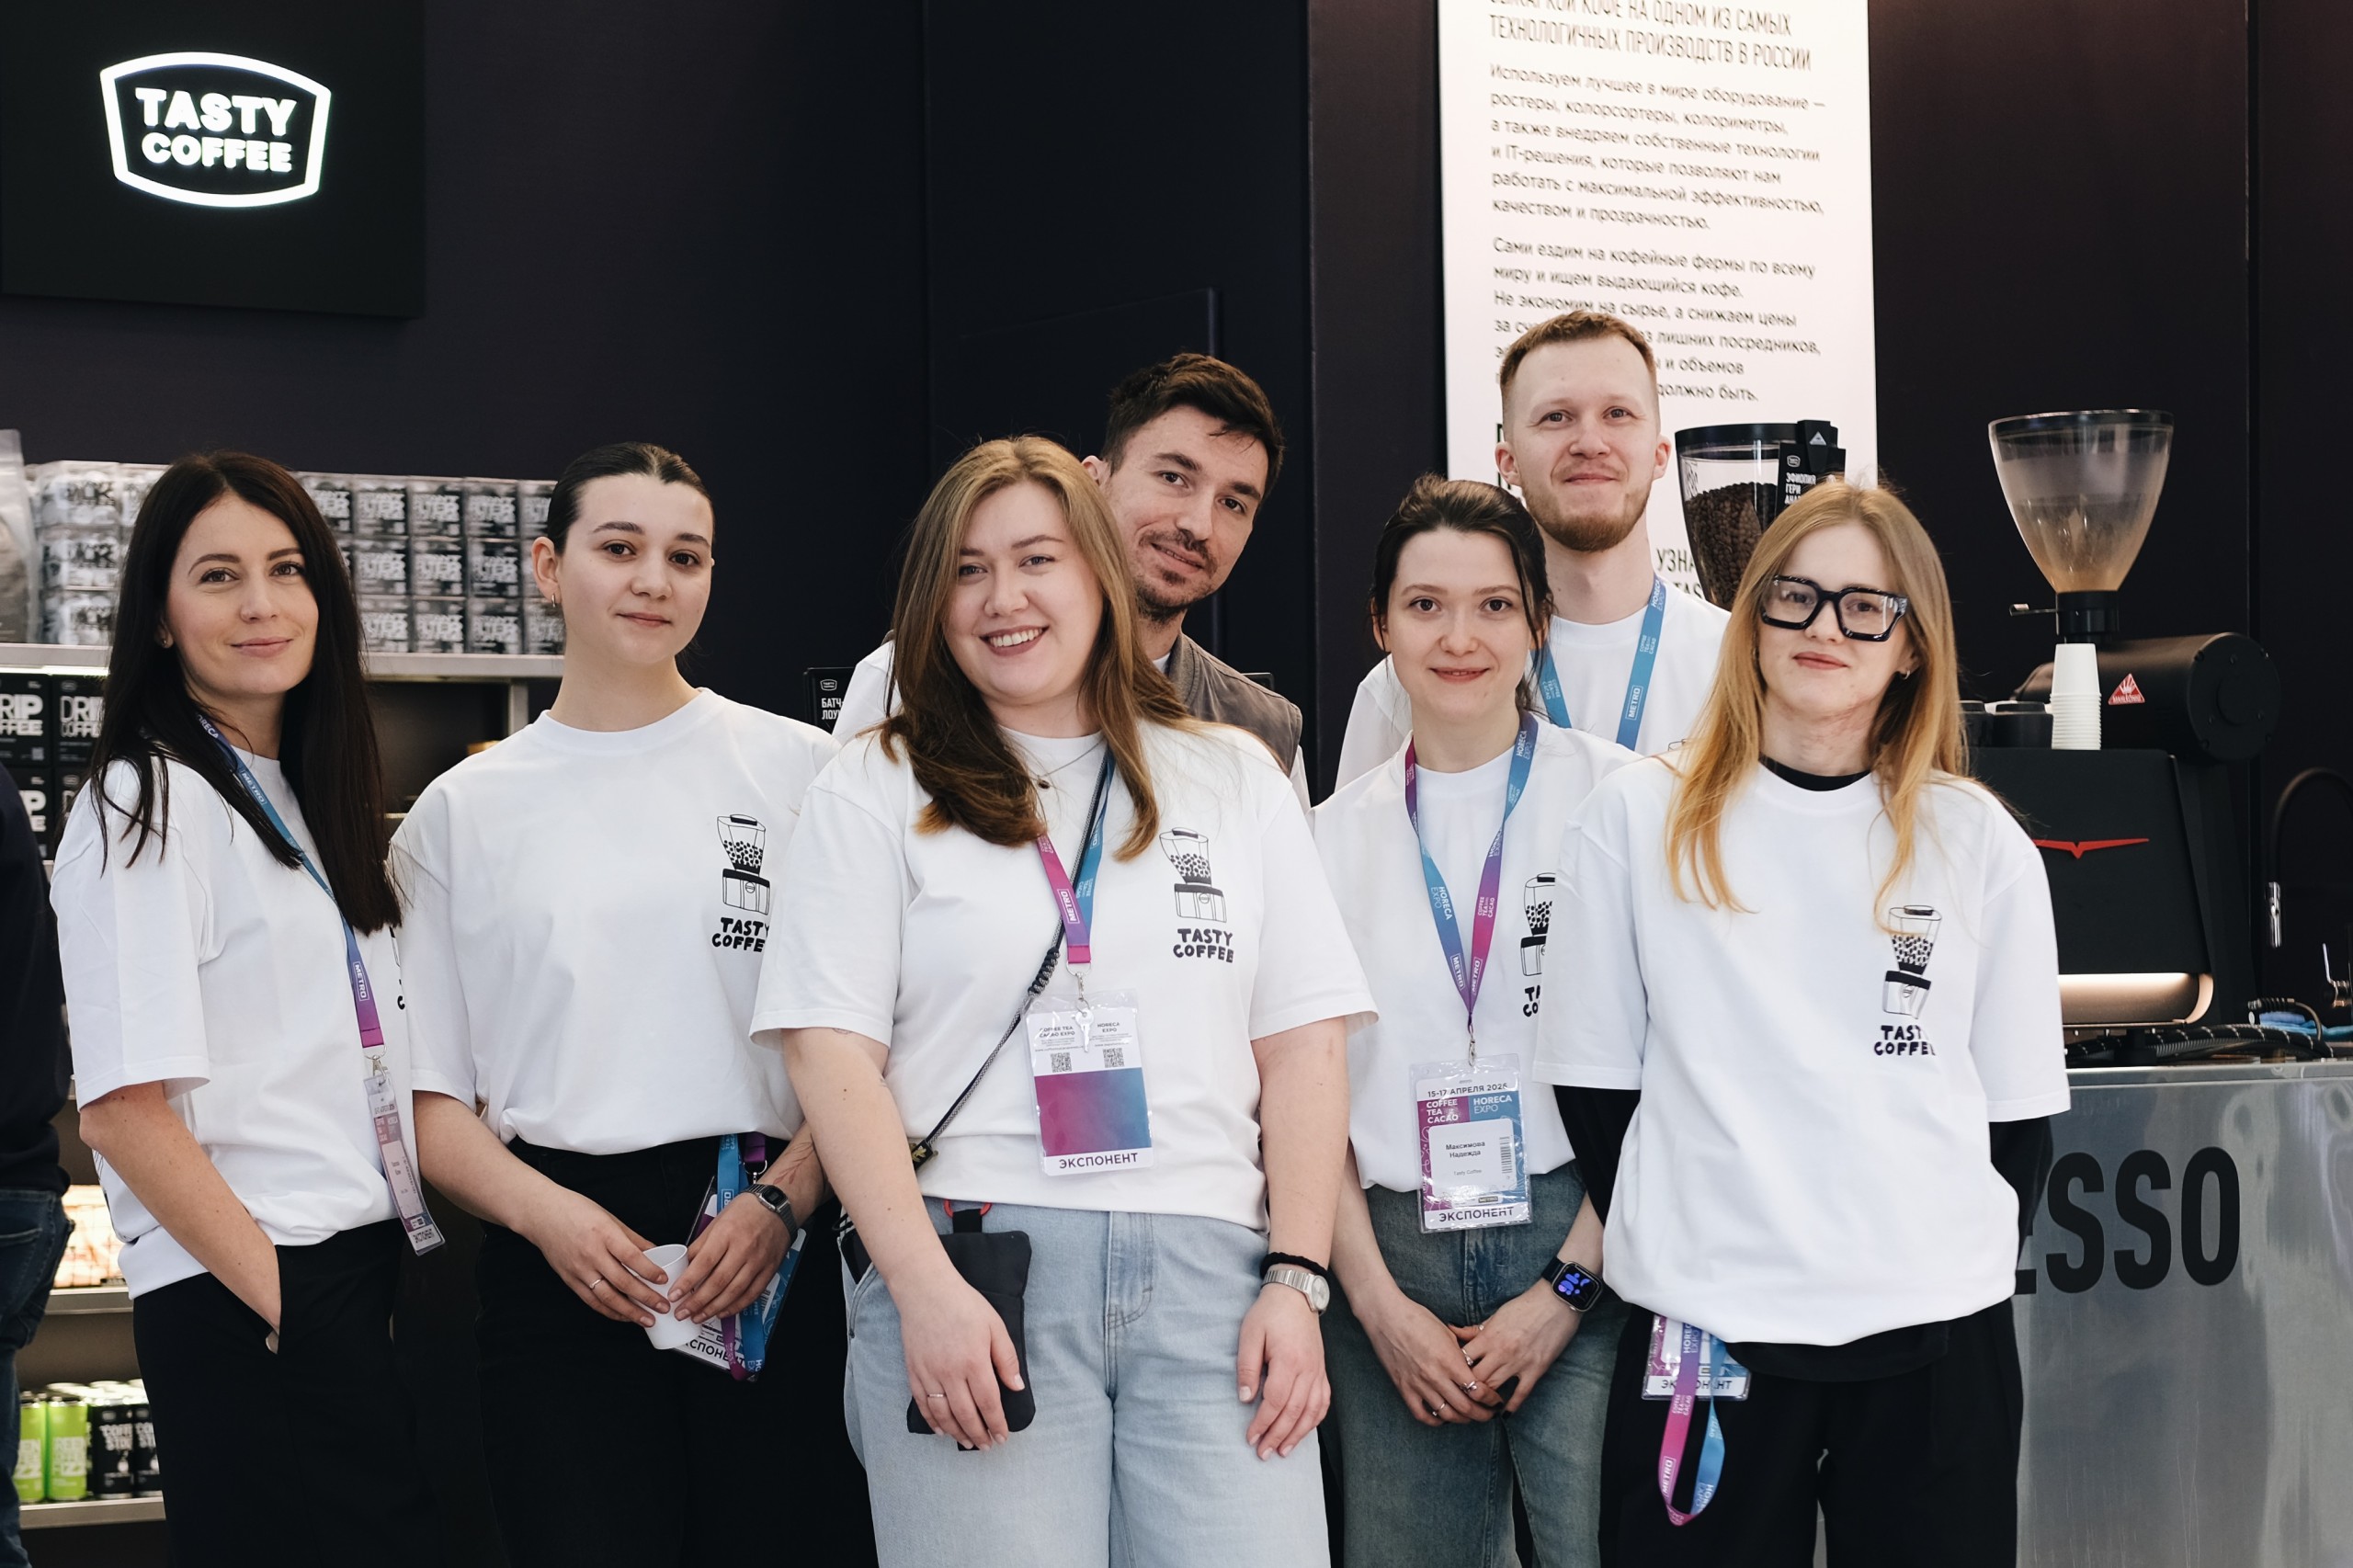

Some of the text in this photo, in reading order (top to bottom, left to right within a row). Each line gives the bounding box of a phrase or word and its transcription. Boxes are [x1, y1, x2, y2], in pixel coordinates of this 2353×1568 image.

[1629, 0, 1648, 20] НА
[1654, 1, 1706, 28] ОДНОМ
[1712, 6, 1731, 29] ИЗ
[1737, 8, 1792, 36] САМЫХ
[1489, 15, 1811, 71] ТЕХНОЛОГИЧНЫХ ПРОИЗВОДСТВ В РОССИИ
[1490, 63, 1581, 88] Используем
[1586, 76, 1643, 92] лучшее
[1647, 83, 1655, 95] в
[1660, 85, 1698, 101] мире
[1702, 86, 1810, 110] оборудование
[135, 87, 297, 136] TASTY
[1491, 93, 1789, 136] ростеры, колорсортеры, колориметры,
[142, 132, 292, 173] COFFEE
[1491, 119, 1821, 162] а также внедряем собственные технологии
[1491, 144, 1781, 184] и IT-решения, которые позволяют нам
[1491, 171, 1824, 216] работать с максимальной эффективностью,
[1492, 199, 1711, 230] качеством и прозрачностью.
[1493, 236, 1816, 279] Сами ездим на кофейные фермы по всему
[1493, 267, 1744, 300] миру и ищем выдающийся кофе.
[1494, 290, 1797, 327] Не экономим на сырье, а снижаем цены
[1495, 320, 1510, 332] за
[1656, 331, 1715, 347] лишних
[1720, 335, 1821, 356] посредников,
[1665, 358, 1675, 369] и
[1679, 356, 1745, 375] объемов
[1719, 383, 1759, 402] быть.
[1628, 687, 1641, 719] METRO
[1516, 731, 1528, 757] HORECA
[241, 772, 265, 803] METRO
[1061, 891, 1077, 922] METRO
[1430, 887, 1442, 909] EXPO
[1438, 886, 1453, 920] HORECA
[721, 917, 769, 937] TASTY
[1177, 928, 1233, 947] TASTY
[1173, 944, 1233, 963] COFFEE
[355, 964, 368, 999] METRO
[1452, 956, 1463, 988] METRO
[1472, 960, 1481, 993] METRO
[1426, 1098, 1458, 1108] COFFEE
[1427, 1089, 1447, 1097] 15-17
[1450, 1085, 1484, 1095] АПРЕЛЯ
[1473, 1095, 1513, 1106] HORECA
[1427, 1114, 1459, 1124] CACAO
[1473, 1105, 1498, 1114] EXPO
[1059, 1153, 1138, 1169] ЭКСПОНЕНТ
[1446, 1141, 1485, 1151] Максимова
[1449, 1150, 1481, 1158] Надежда
[1439, 1207, 1514, 1222] ЭКСПОНЕНТ
[1662, 1460, 1673, 1494] METRO
